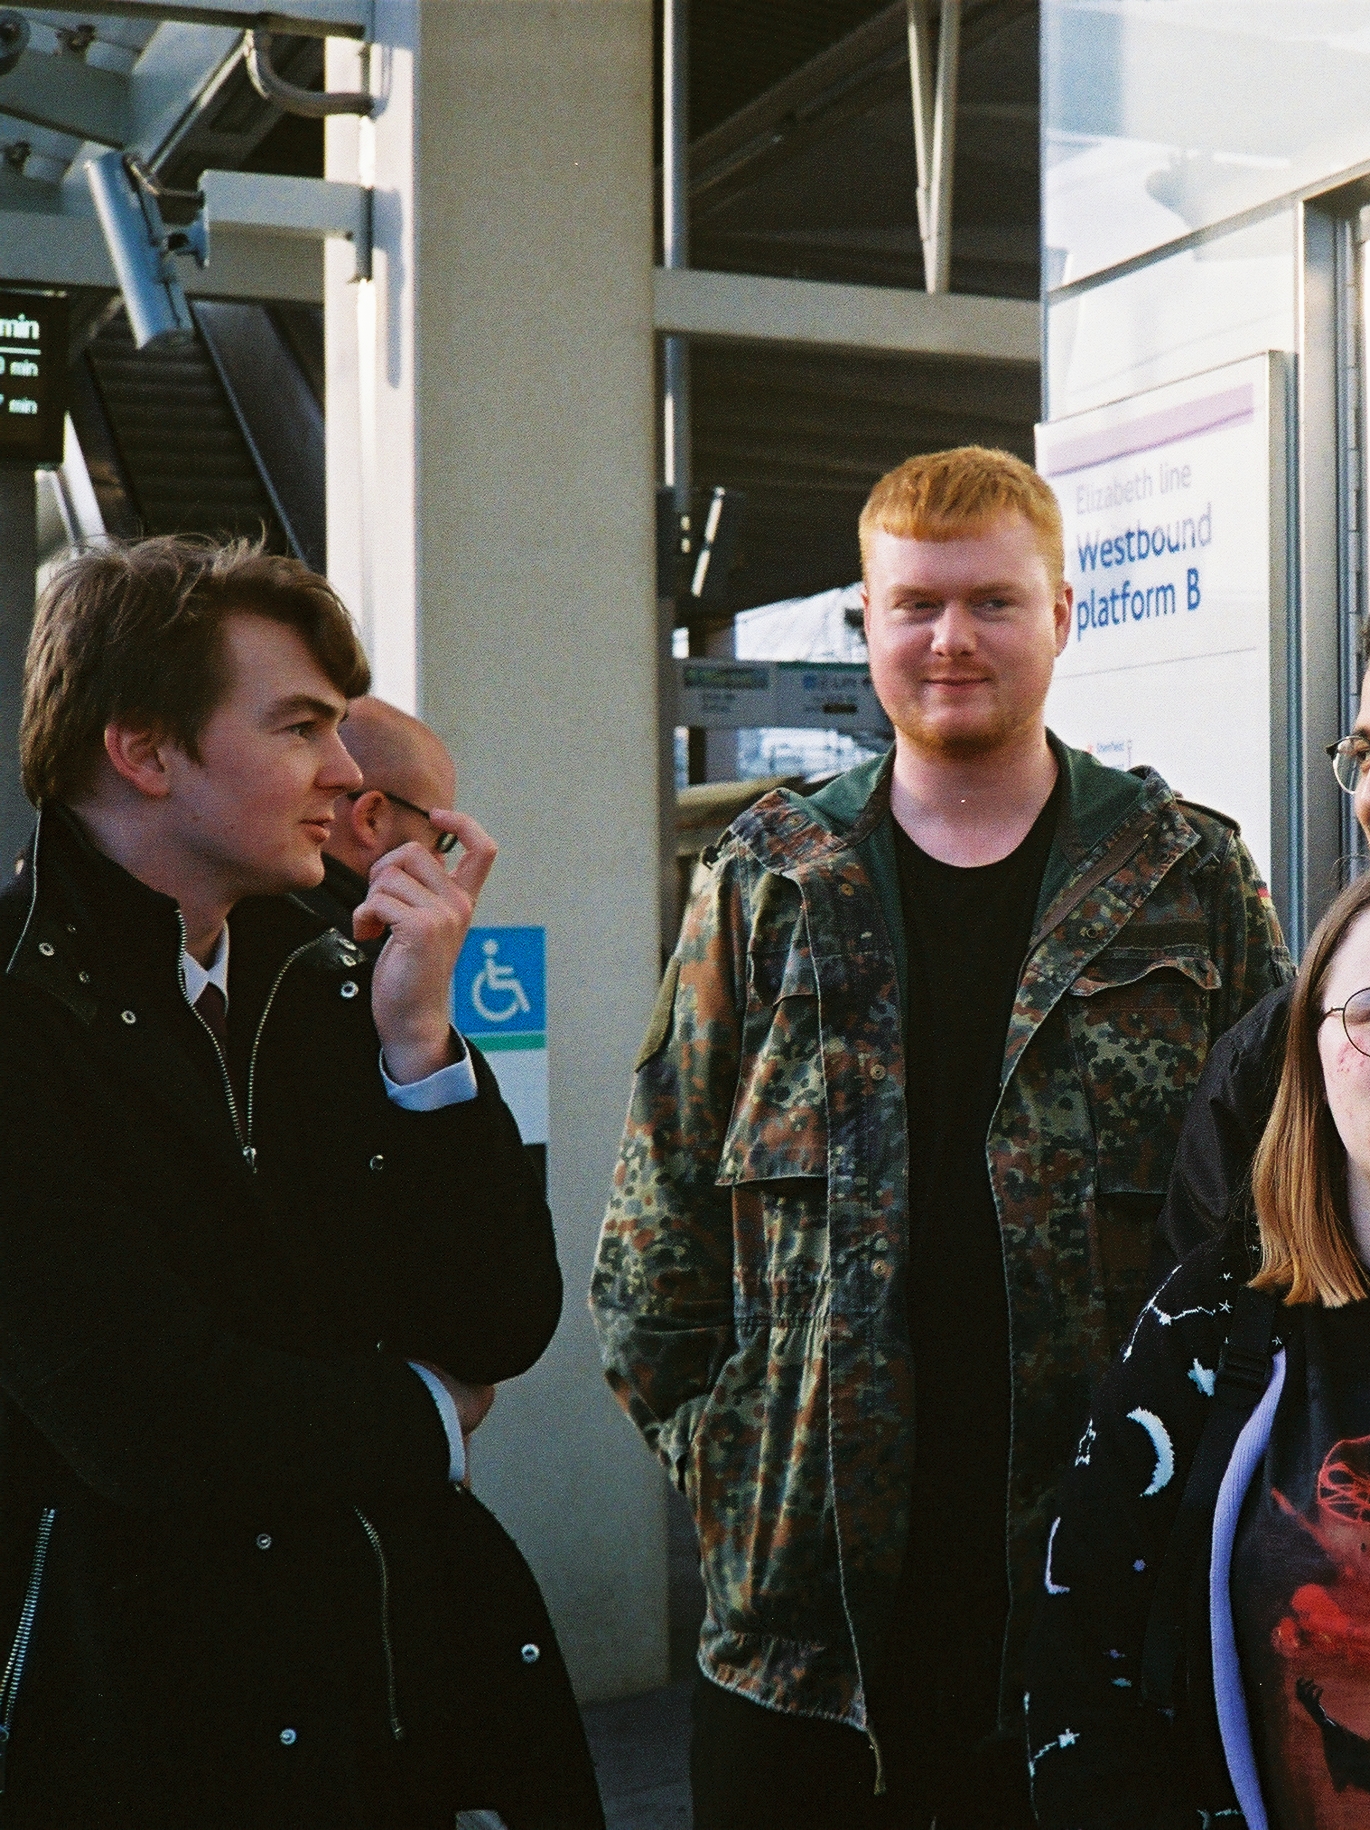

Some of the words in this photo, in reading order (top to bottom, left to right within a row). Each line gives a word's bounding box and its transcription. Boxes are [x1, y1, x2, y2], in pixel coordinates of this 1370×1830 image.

[10, 359, 39, 377] min
[9, 397, 38, 414] min
[1076, 467, 1153, 515] Elizabeth
[1159, 462, 1192, 494] line
[1077, 502, 1212, 573] Westbound
[1077, 580, 1176, 642] platform
[1186, 567, 1201, 611] B
